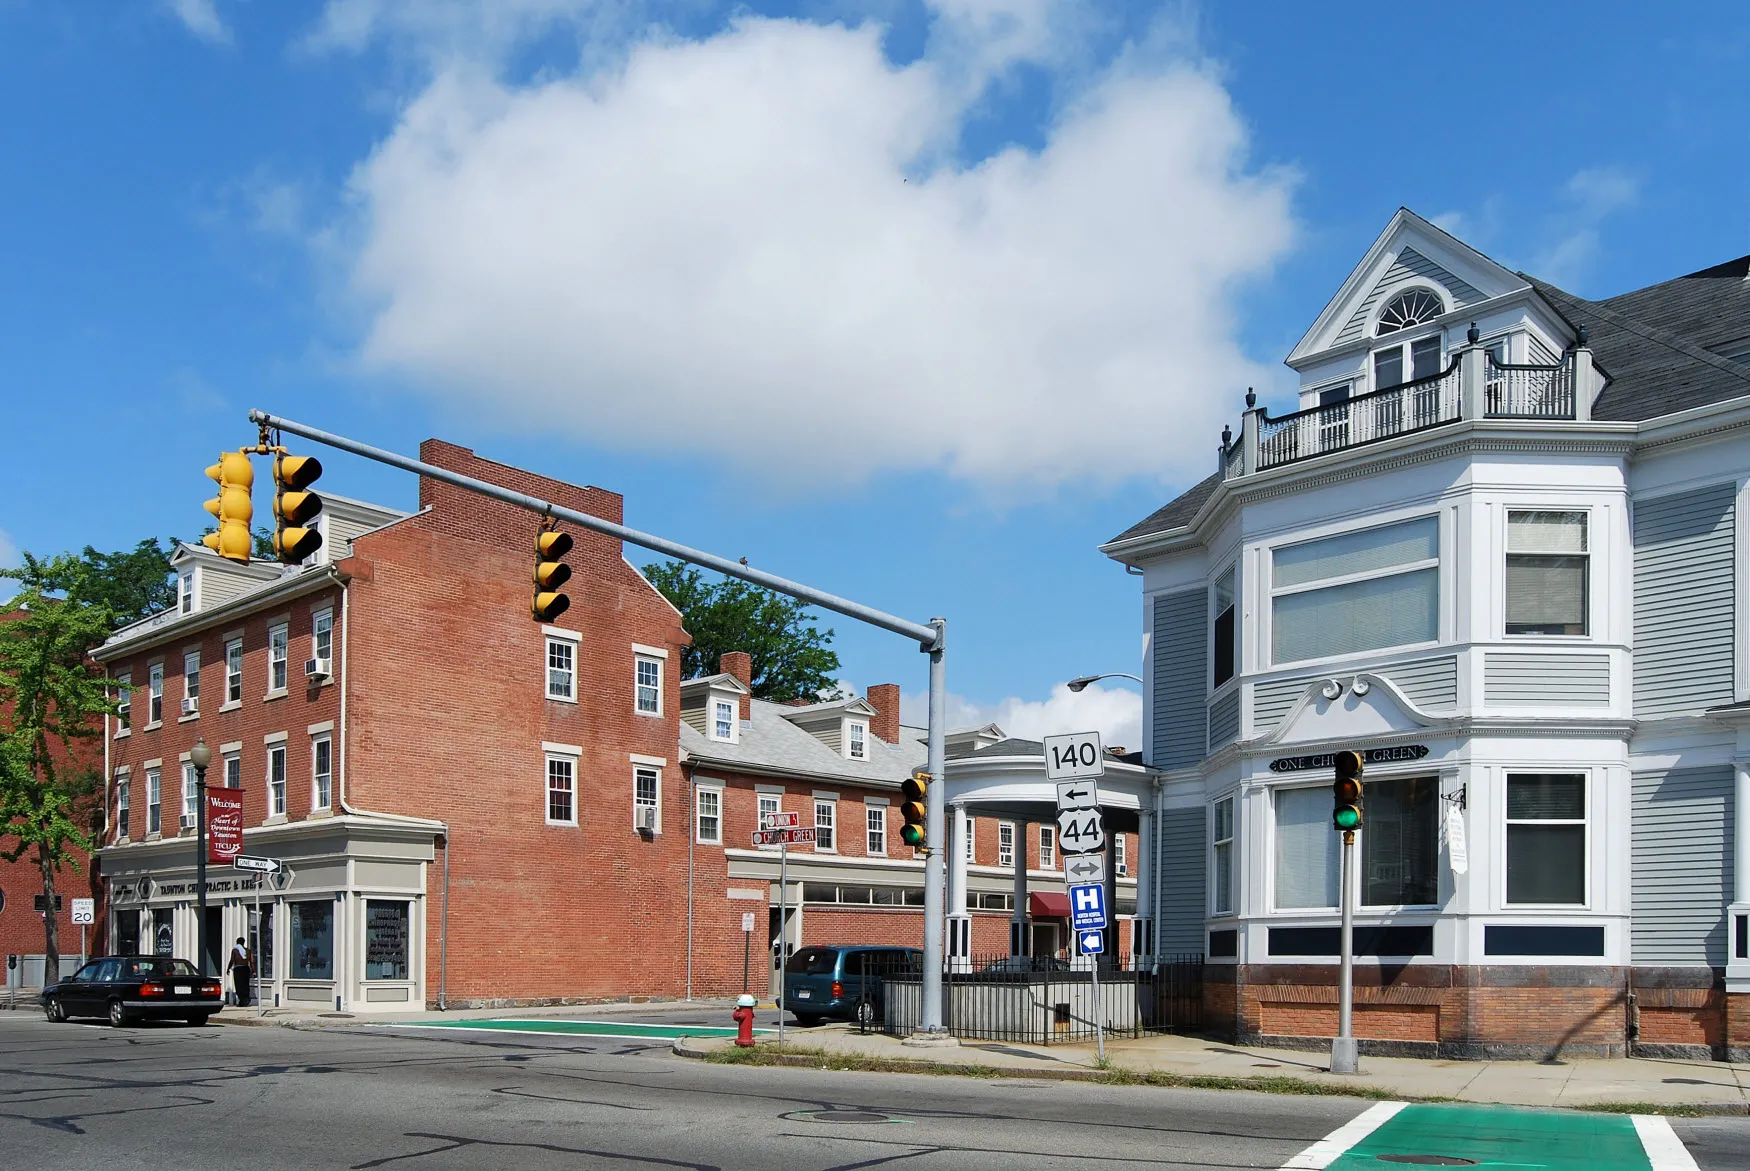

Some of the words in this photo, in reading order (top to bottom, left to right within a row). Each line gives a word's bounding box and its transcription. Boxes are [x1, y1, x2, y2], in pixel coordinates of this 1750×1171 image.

[1051, 742, 1096, 770] 140
[1279, 757, 1305, 771] ONE
[1373, 746, 1417, 761] GREEN
[210, 824, 241, 832] Downtown
[774, 814, 791, 827] UNION
[763, 831, 789, 844] CHURCH
[792, 829, 814, 842] GREEN
[1063, 817, 1099, 843] 44
[239, 859, 251, 867] ONE
[160, 883, 186, 896] TAUNTON
[233, 881, 239, 890] &
[1076, 888, 1099, 911] H
[74, 912, 92, 922] 20
